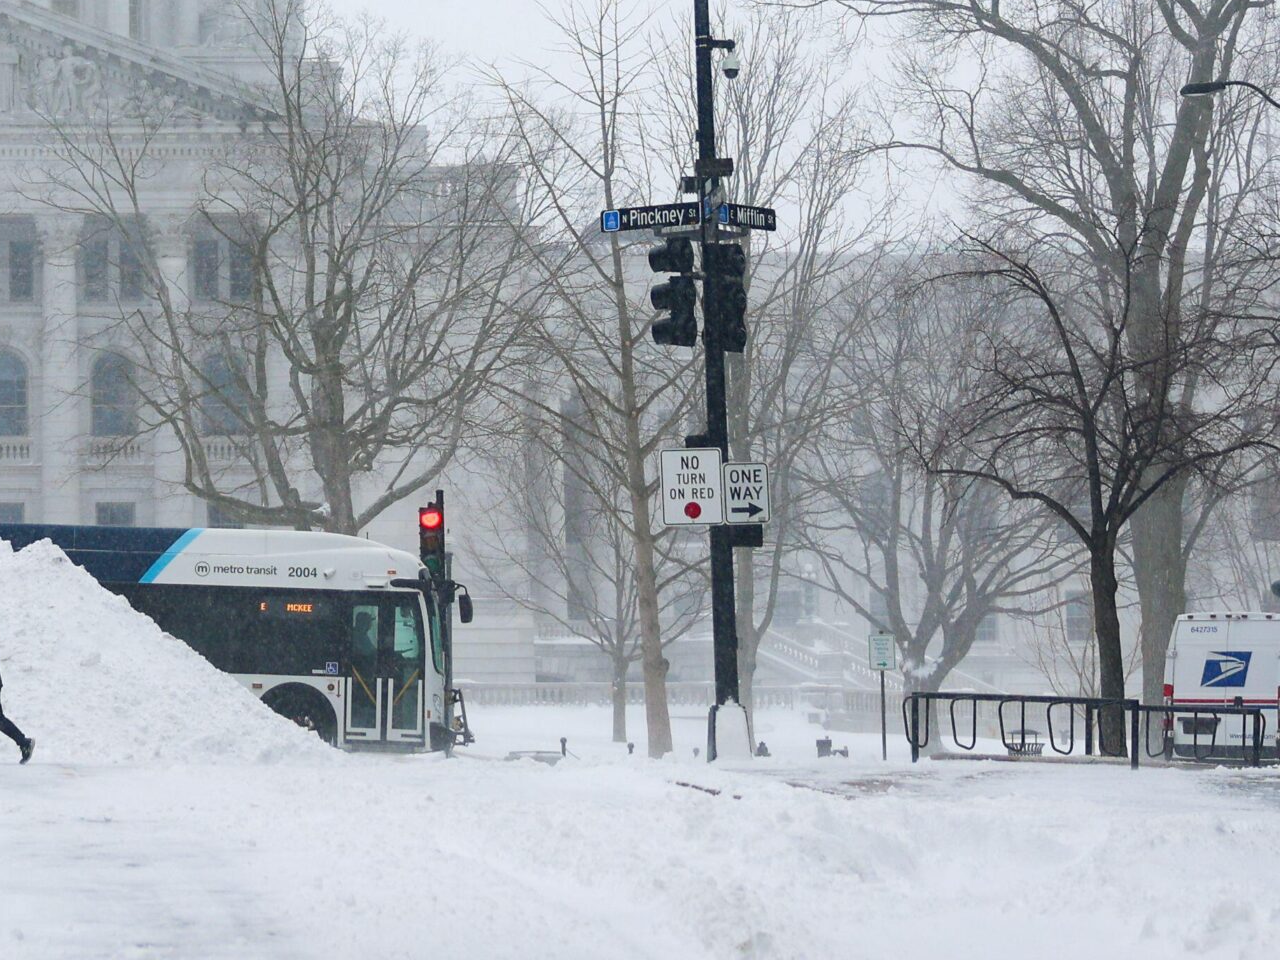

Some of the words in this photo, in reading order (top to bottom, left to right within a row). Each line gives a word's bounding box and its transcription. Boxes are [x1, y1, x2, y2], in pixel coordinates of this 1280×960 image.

[622, 214, 627, 223] N
[629, 208, 684, 226] Pinckney
[688, 208, 696, 217] St
[737, 207, 765, 226] Mifflin
[767, 214, 774, 224] St
[680, 455, 699, 470] NO
[676, 473, 706, 485] TURN
[729, 469, 762, 484] ONE
[670, 488, 685, 500] ON
[691, 487, 714, 499] RED
[729, 486, 763, 501] WAY
[213, 565, 245, 575] metro
[246, 565, 278, 576] transit
[288, 566, 318, 578] 2004
[260, 602, 266, 611] E
[286, 603, 313, 613] MCKEE
